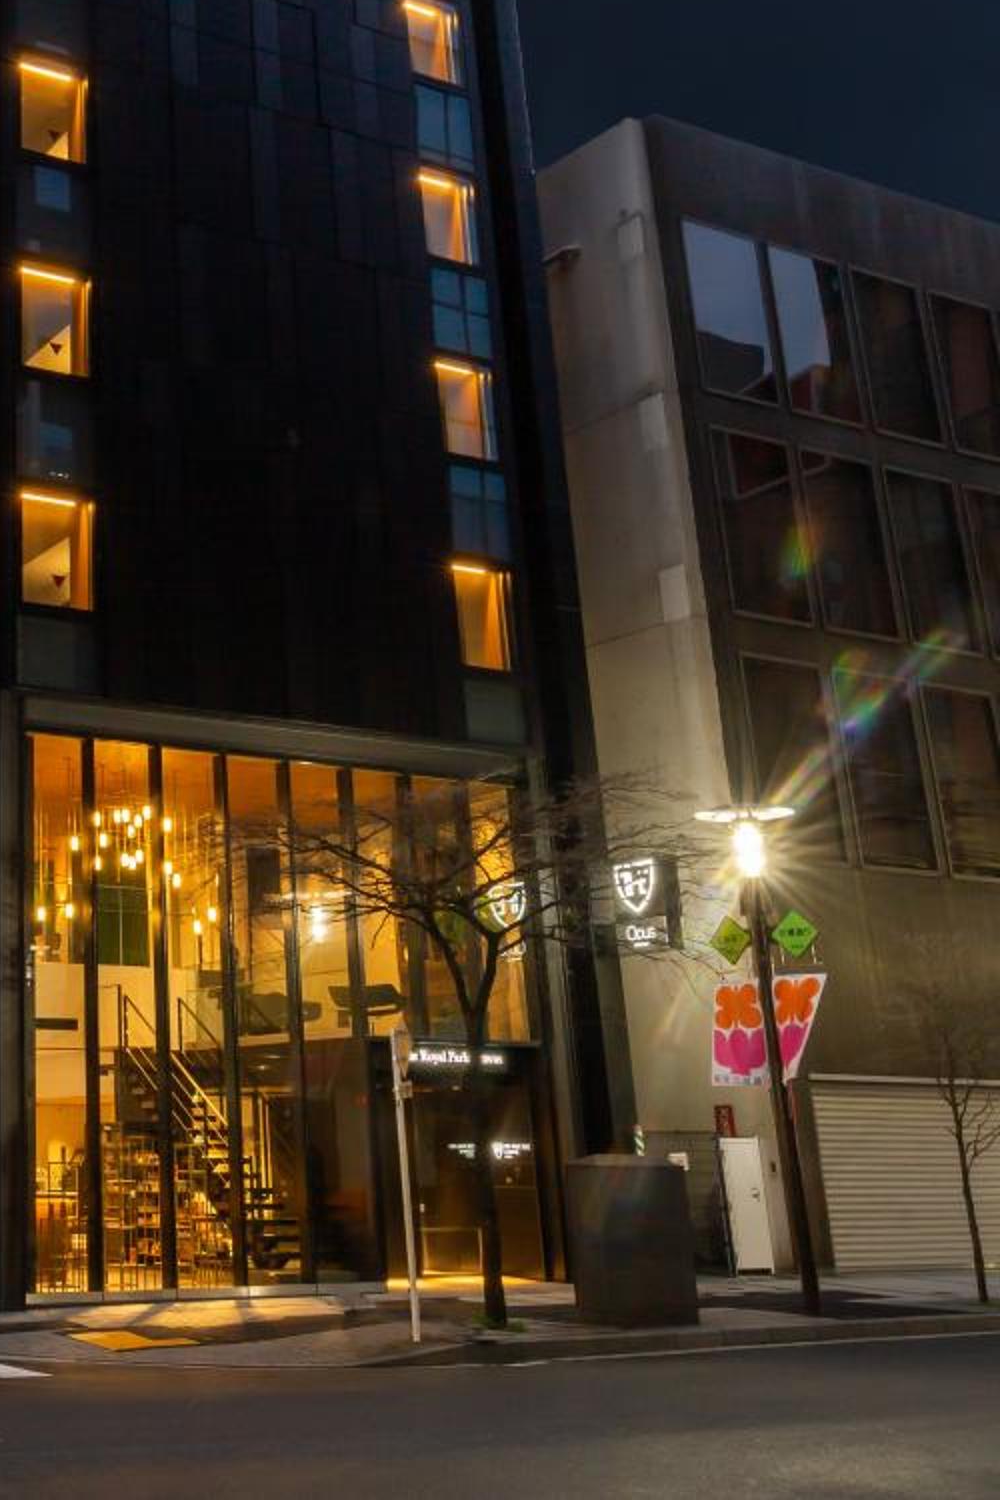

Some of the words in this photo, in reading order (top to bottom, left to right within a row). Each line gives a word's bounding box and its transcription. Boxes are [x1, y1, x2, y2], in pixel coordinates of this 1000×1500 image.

[625, 925, 657, 942] Opus
[419, 1049, 447, 1066] Royal
[448, 1050, 471, 1063] Park
